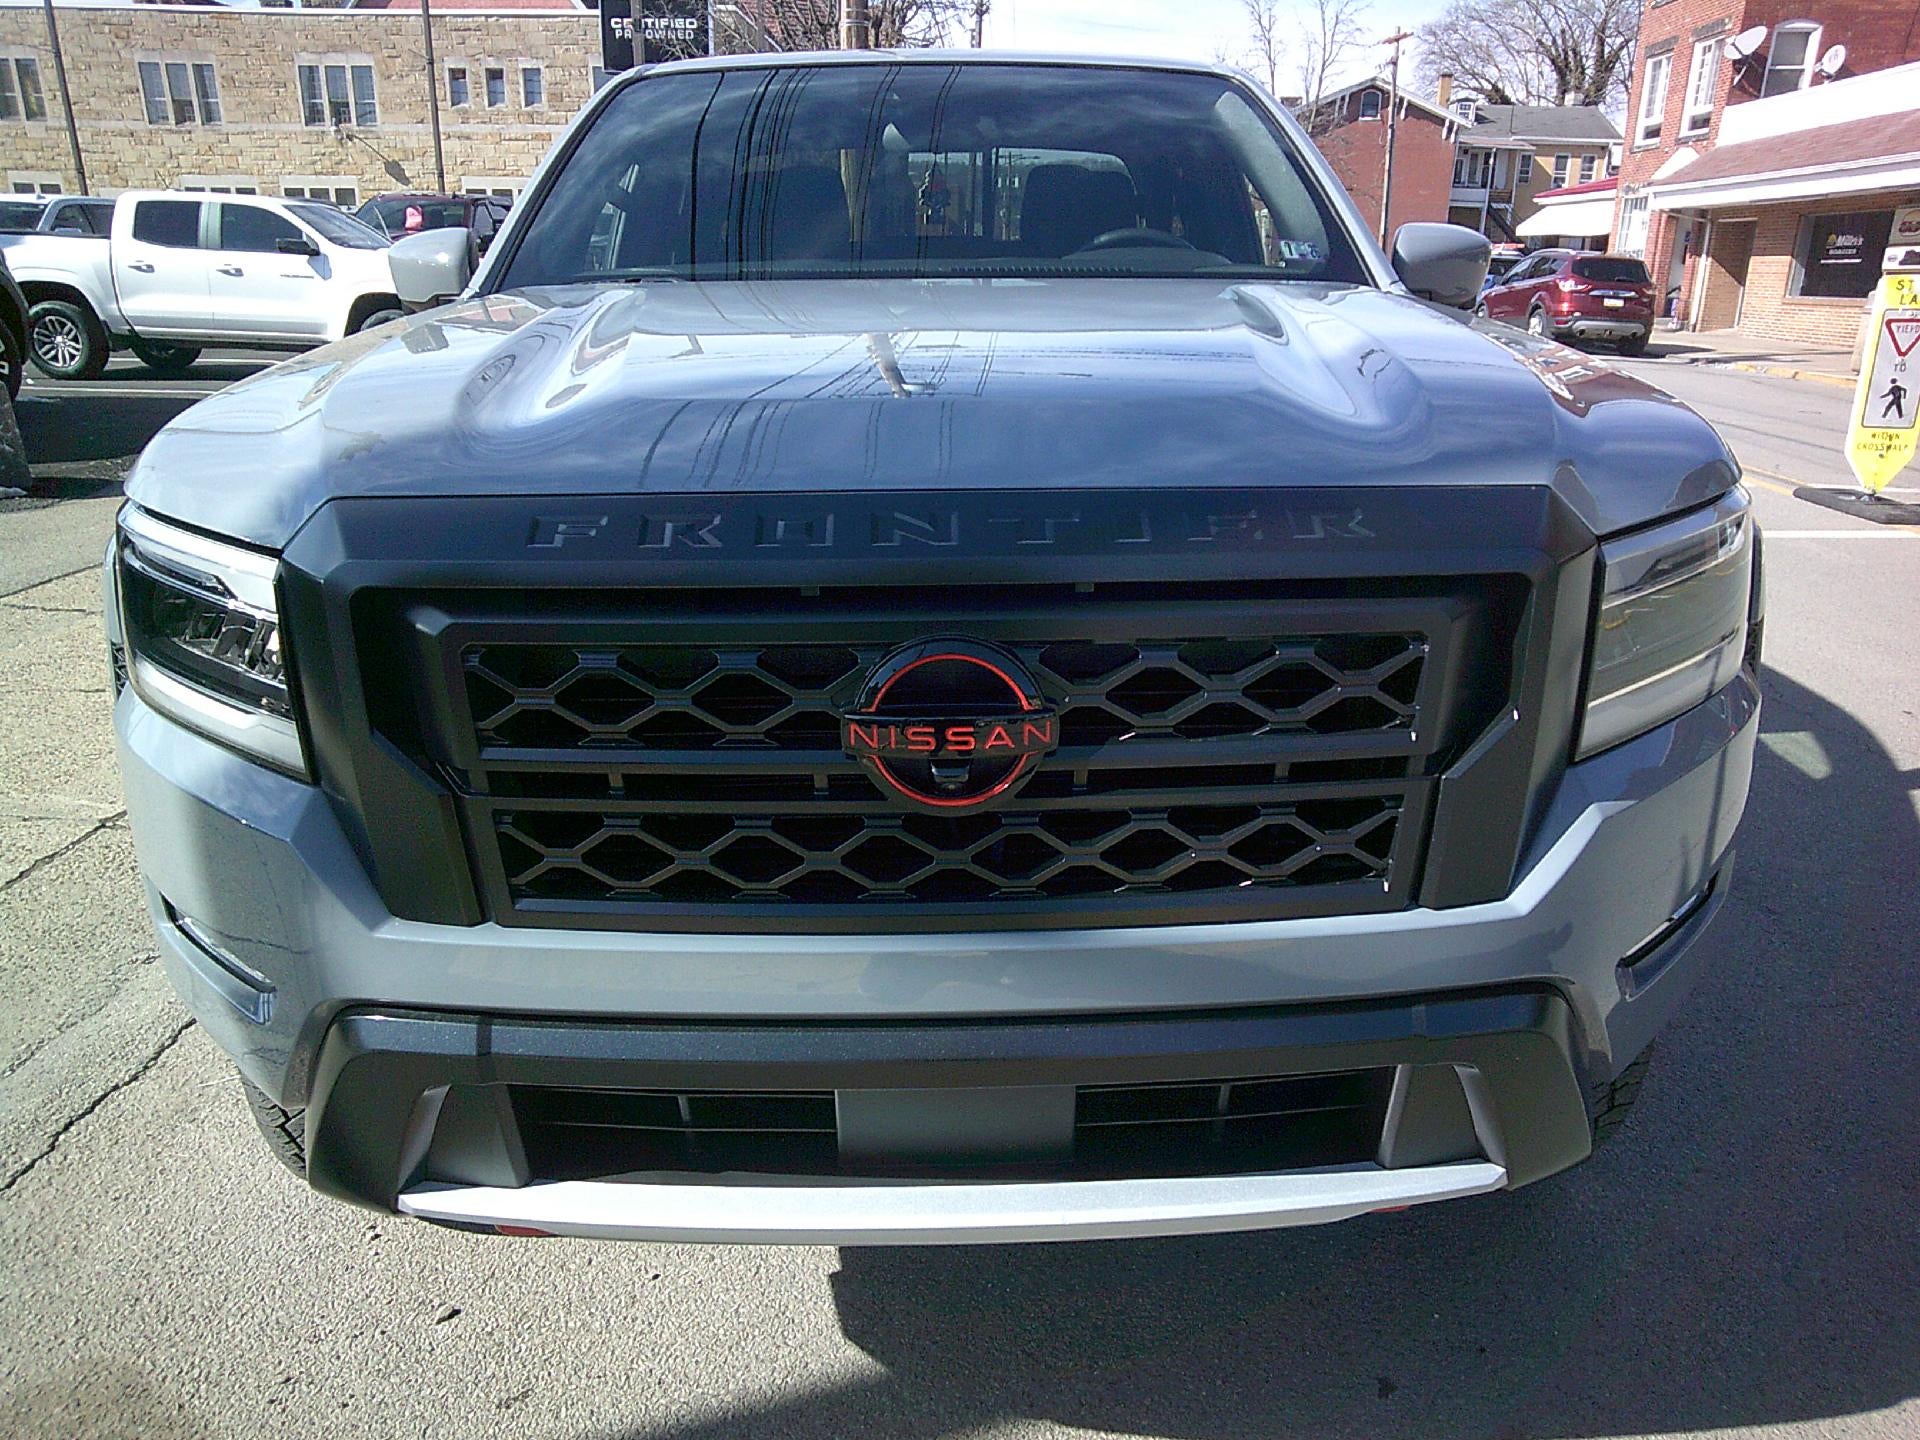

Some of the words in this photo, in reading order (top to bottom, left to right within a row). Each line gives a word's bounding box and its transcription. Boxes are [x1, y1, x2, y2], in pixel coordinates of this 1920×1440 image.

[610, 17, 698, 29] CETIFIED
[526, 506, 1376, 548] FRONTIER
[848, 719, 1052, 752] NISSAN
